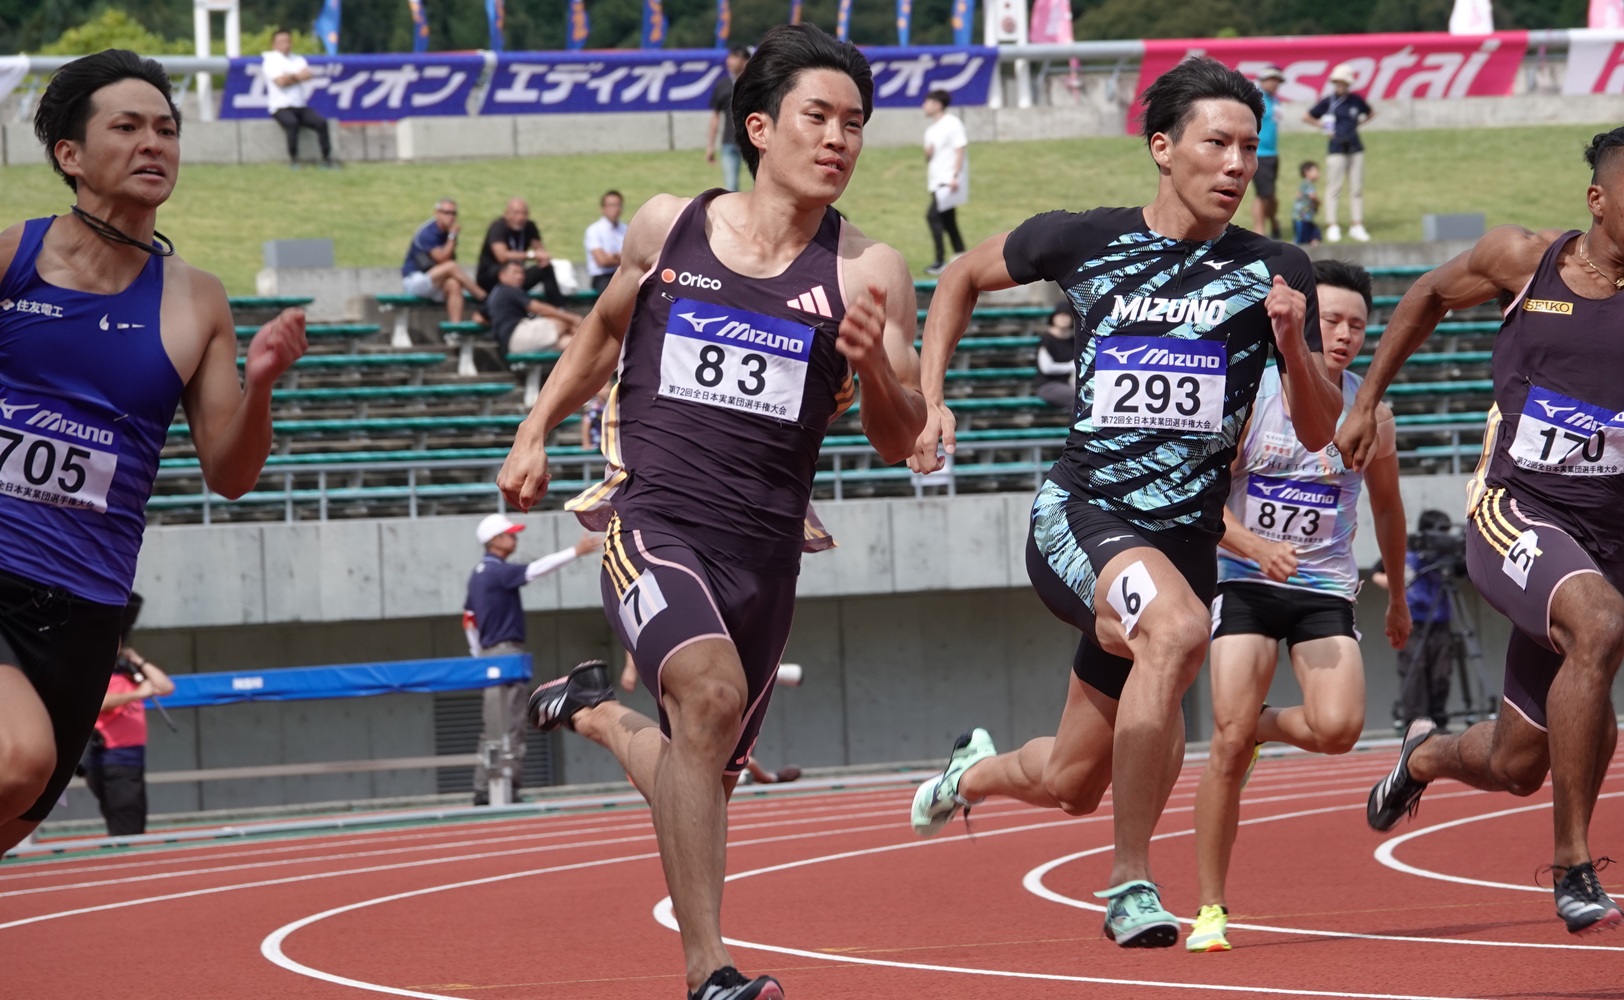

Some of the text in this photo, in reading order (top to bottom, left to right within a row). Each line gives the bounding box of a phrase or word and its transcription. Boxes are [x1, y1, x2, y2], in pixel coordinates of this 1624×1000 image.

[493, 61, 724, 104] エディオン
[678, 272, 722, 290] Orico
[17, 299, 64, 318] 住友電工
[1110, 295, 1227, 326] MIZUNO
[1525, 300, 1570, 313] SEIKO
[716, 321, 804, 353] MIZUNO
[694, 344, 768, 396] 83
[1139, 348, 1221, 369] MIZUNO
[668, 384, 787, 416] 第72回全日本実業団選手権大会
[1113, 373, 1202, 416] 293
[25, 410, 114, 446] MIZUNO
[1100, 415, 1212, 429] 第72回全日本実業団選手権大会
[1540, 427, 1605, 464] 170
[1278, 487, 1335, 504] MIZUNO
[1258, 502, 1321, 536] 873
[1509, 542, 1532, 572] 5
[623, 584, 643, 627] 7
[1121, 576, 1142, 616] 6
